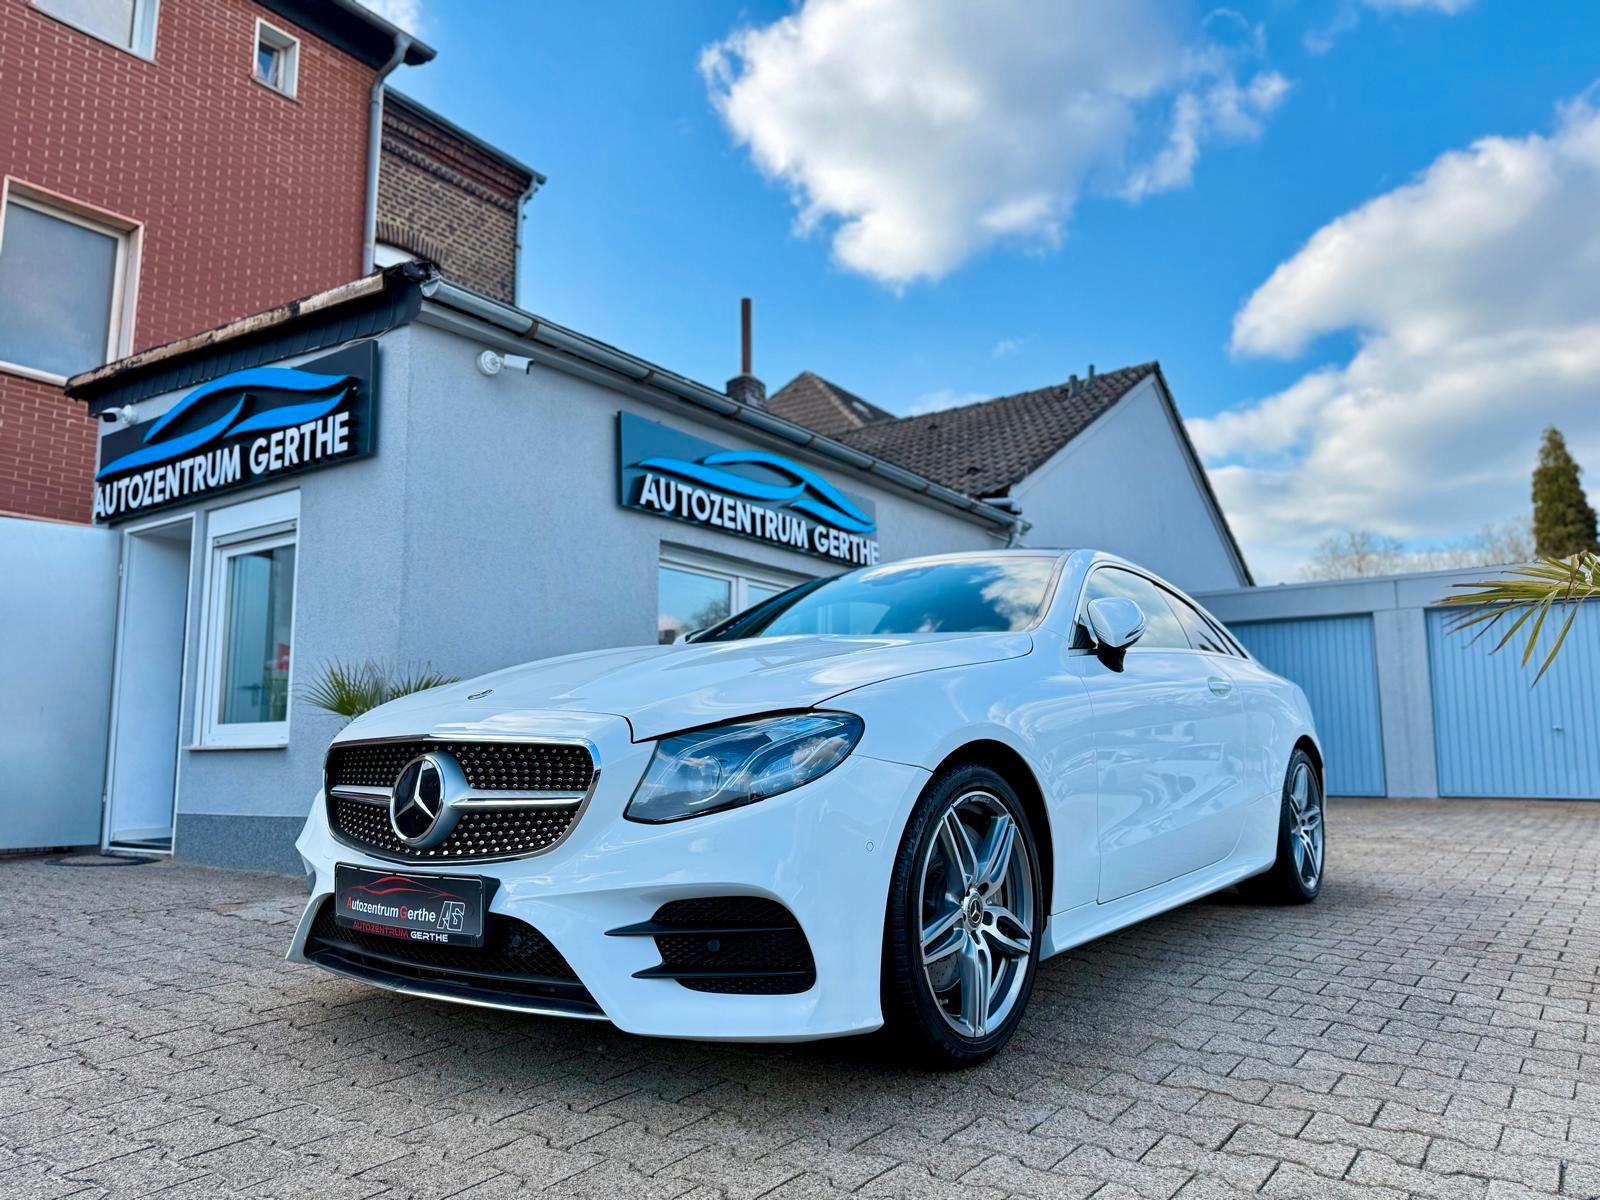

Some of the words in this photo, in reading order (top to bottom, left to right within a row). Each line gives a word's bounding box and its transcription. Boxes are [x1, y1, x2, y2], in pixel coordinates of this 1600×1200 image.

[93, 444, 242, 518] AUTOZENTRUM
[250, 411, 349, 475] GERTHE
[639, 473, 808, 549] AUTOZENTRUM
[813, 528, 880, 566] GERTHE
[347, 897, 398, 918] Autozentrum
[400, 905, 436, 922] Gerthe
[353, 920, 409, 938] AUTOZENTRUM
[410, 931, 449, 942] GERTHE
